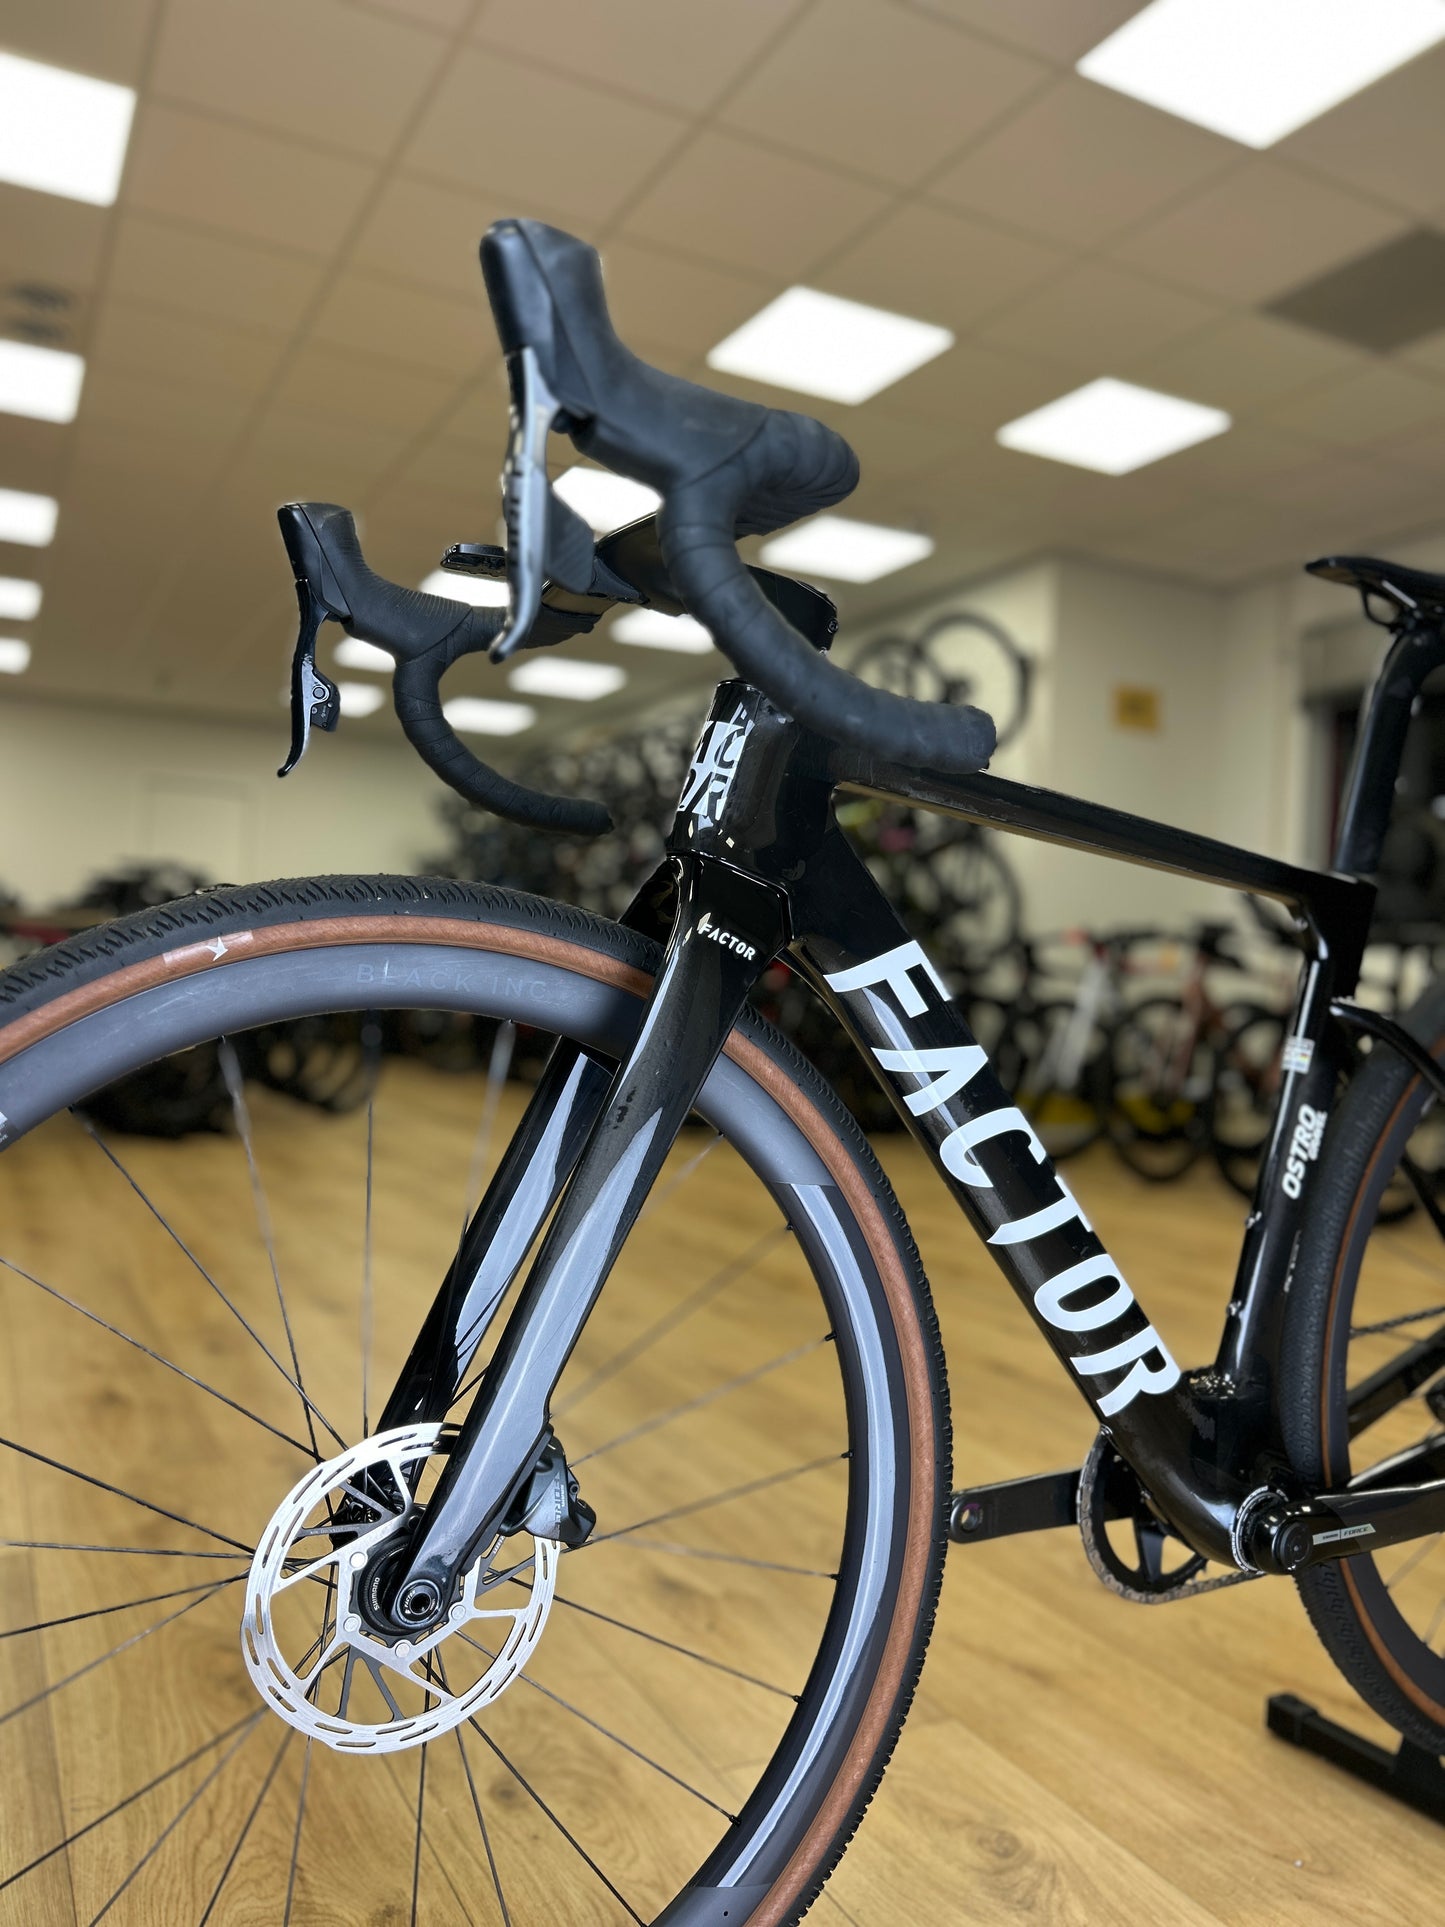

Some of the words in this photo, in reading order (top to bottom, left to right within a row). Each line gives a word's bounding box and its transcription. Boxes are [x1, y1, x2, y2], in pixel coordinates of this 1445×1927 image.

[698, 924, 757, 961] FACTOR
[356, 960, 473, 994] BLACK
[490, 976, 548, 1001] INC
[1281, 1104, 1315, 1200] OSTRO
[823, 940, 1181, 1417] FACTOR
[371, 1577, 381, 1611] SHIMANO
